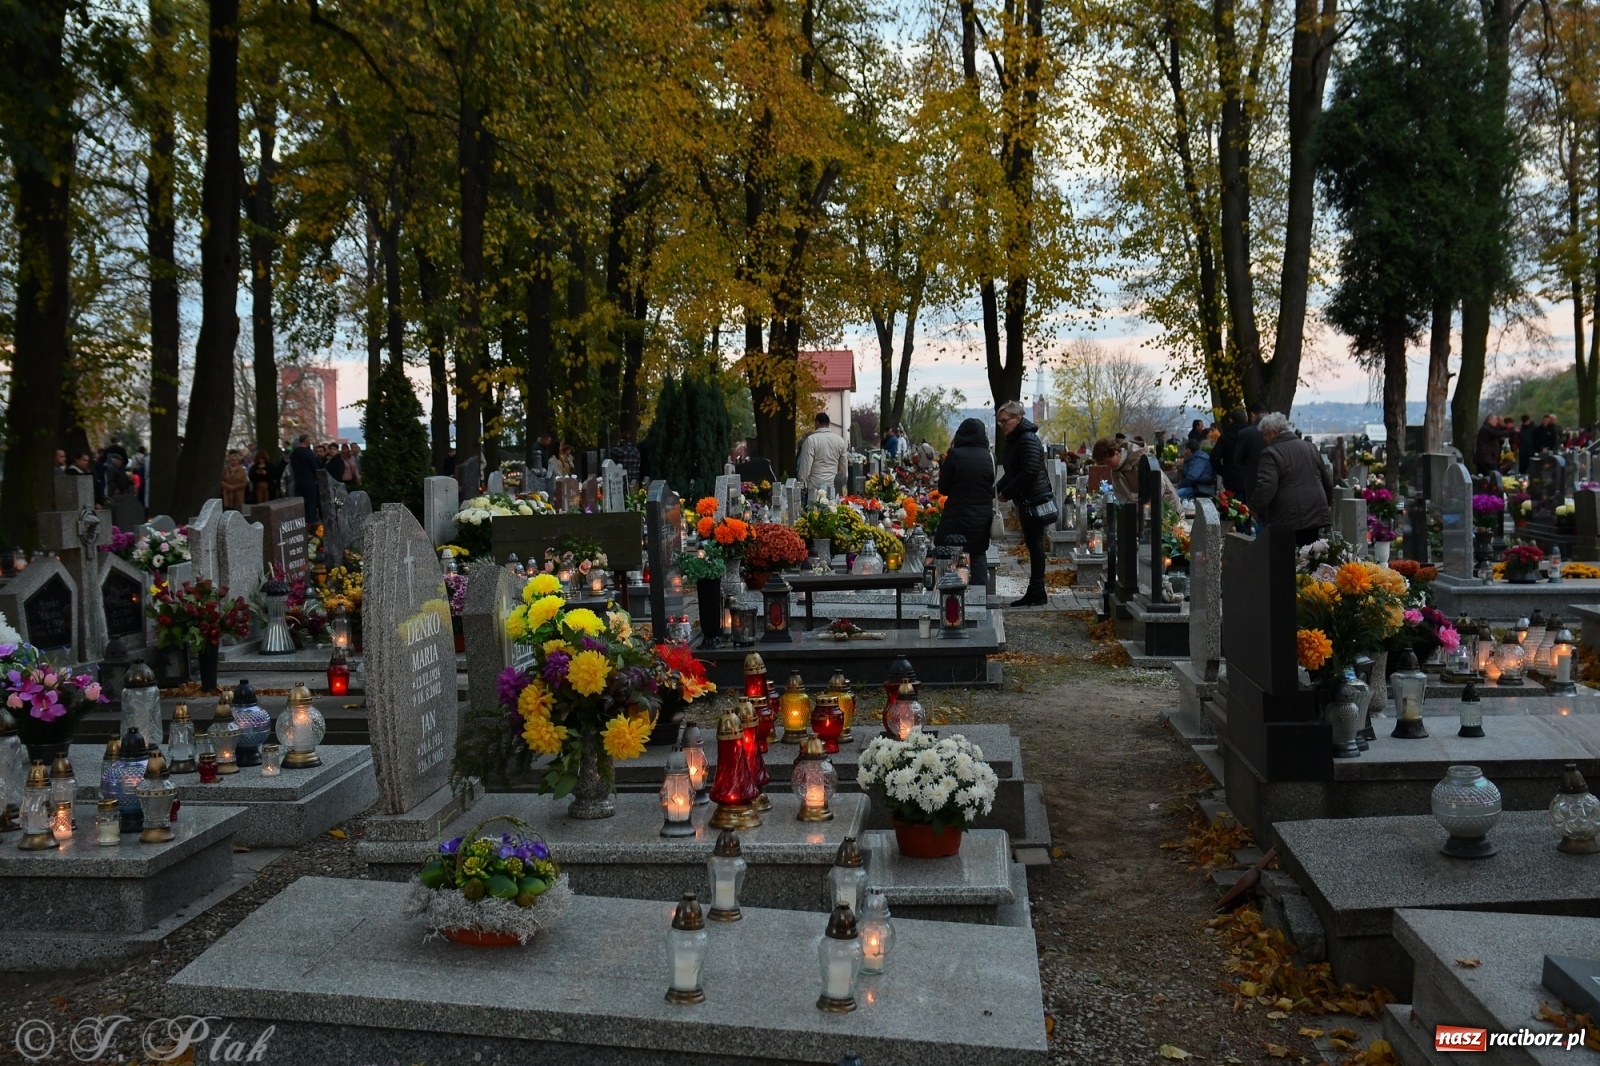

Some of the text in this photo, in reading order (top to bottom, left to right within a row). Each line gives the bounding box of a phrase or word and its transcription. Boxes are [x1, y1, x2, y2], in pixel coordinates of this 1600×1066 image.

[407, 611, 440, 646] DENKO
[412, 643, 439, 672] MARIA
[421, 709, 436, 738] JAN
